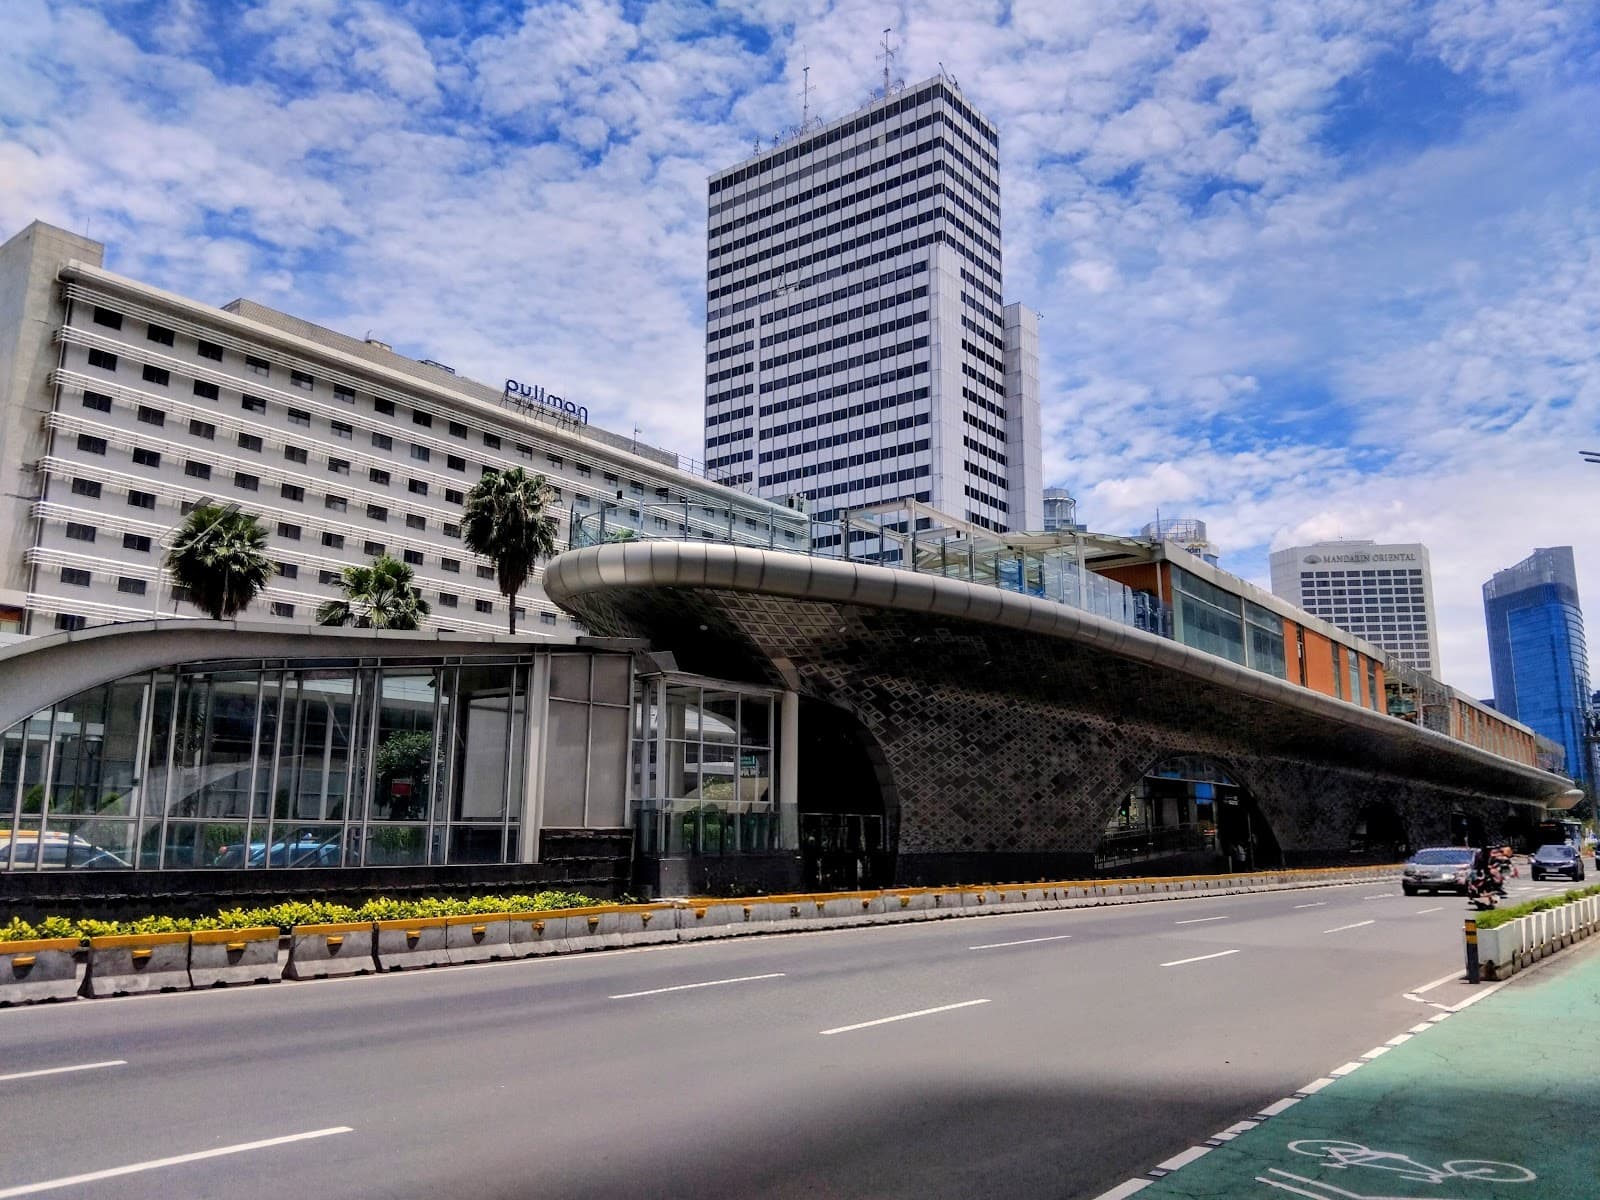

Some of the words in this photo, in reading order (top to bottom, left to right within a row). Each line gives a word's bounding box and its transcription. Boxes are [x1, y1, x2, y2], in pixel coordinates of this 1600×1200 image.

[506, 380, 588, 425] pullman
[1323, 553, 1370, 563] MANDARIN
[1372, 553, 1416, 562] ORIENTAL
